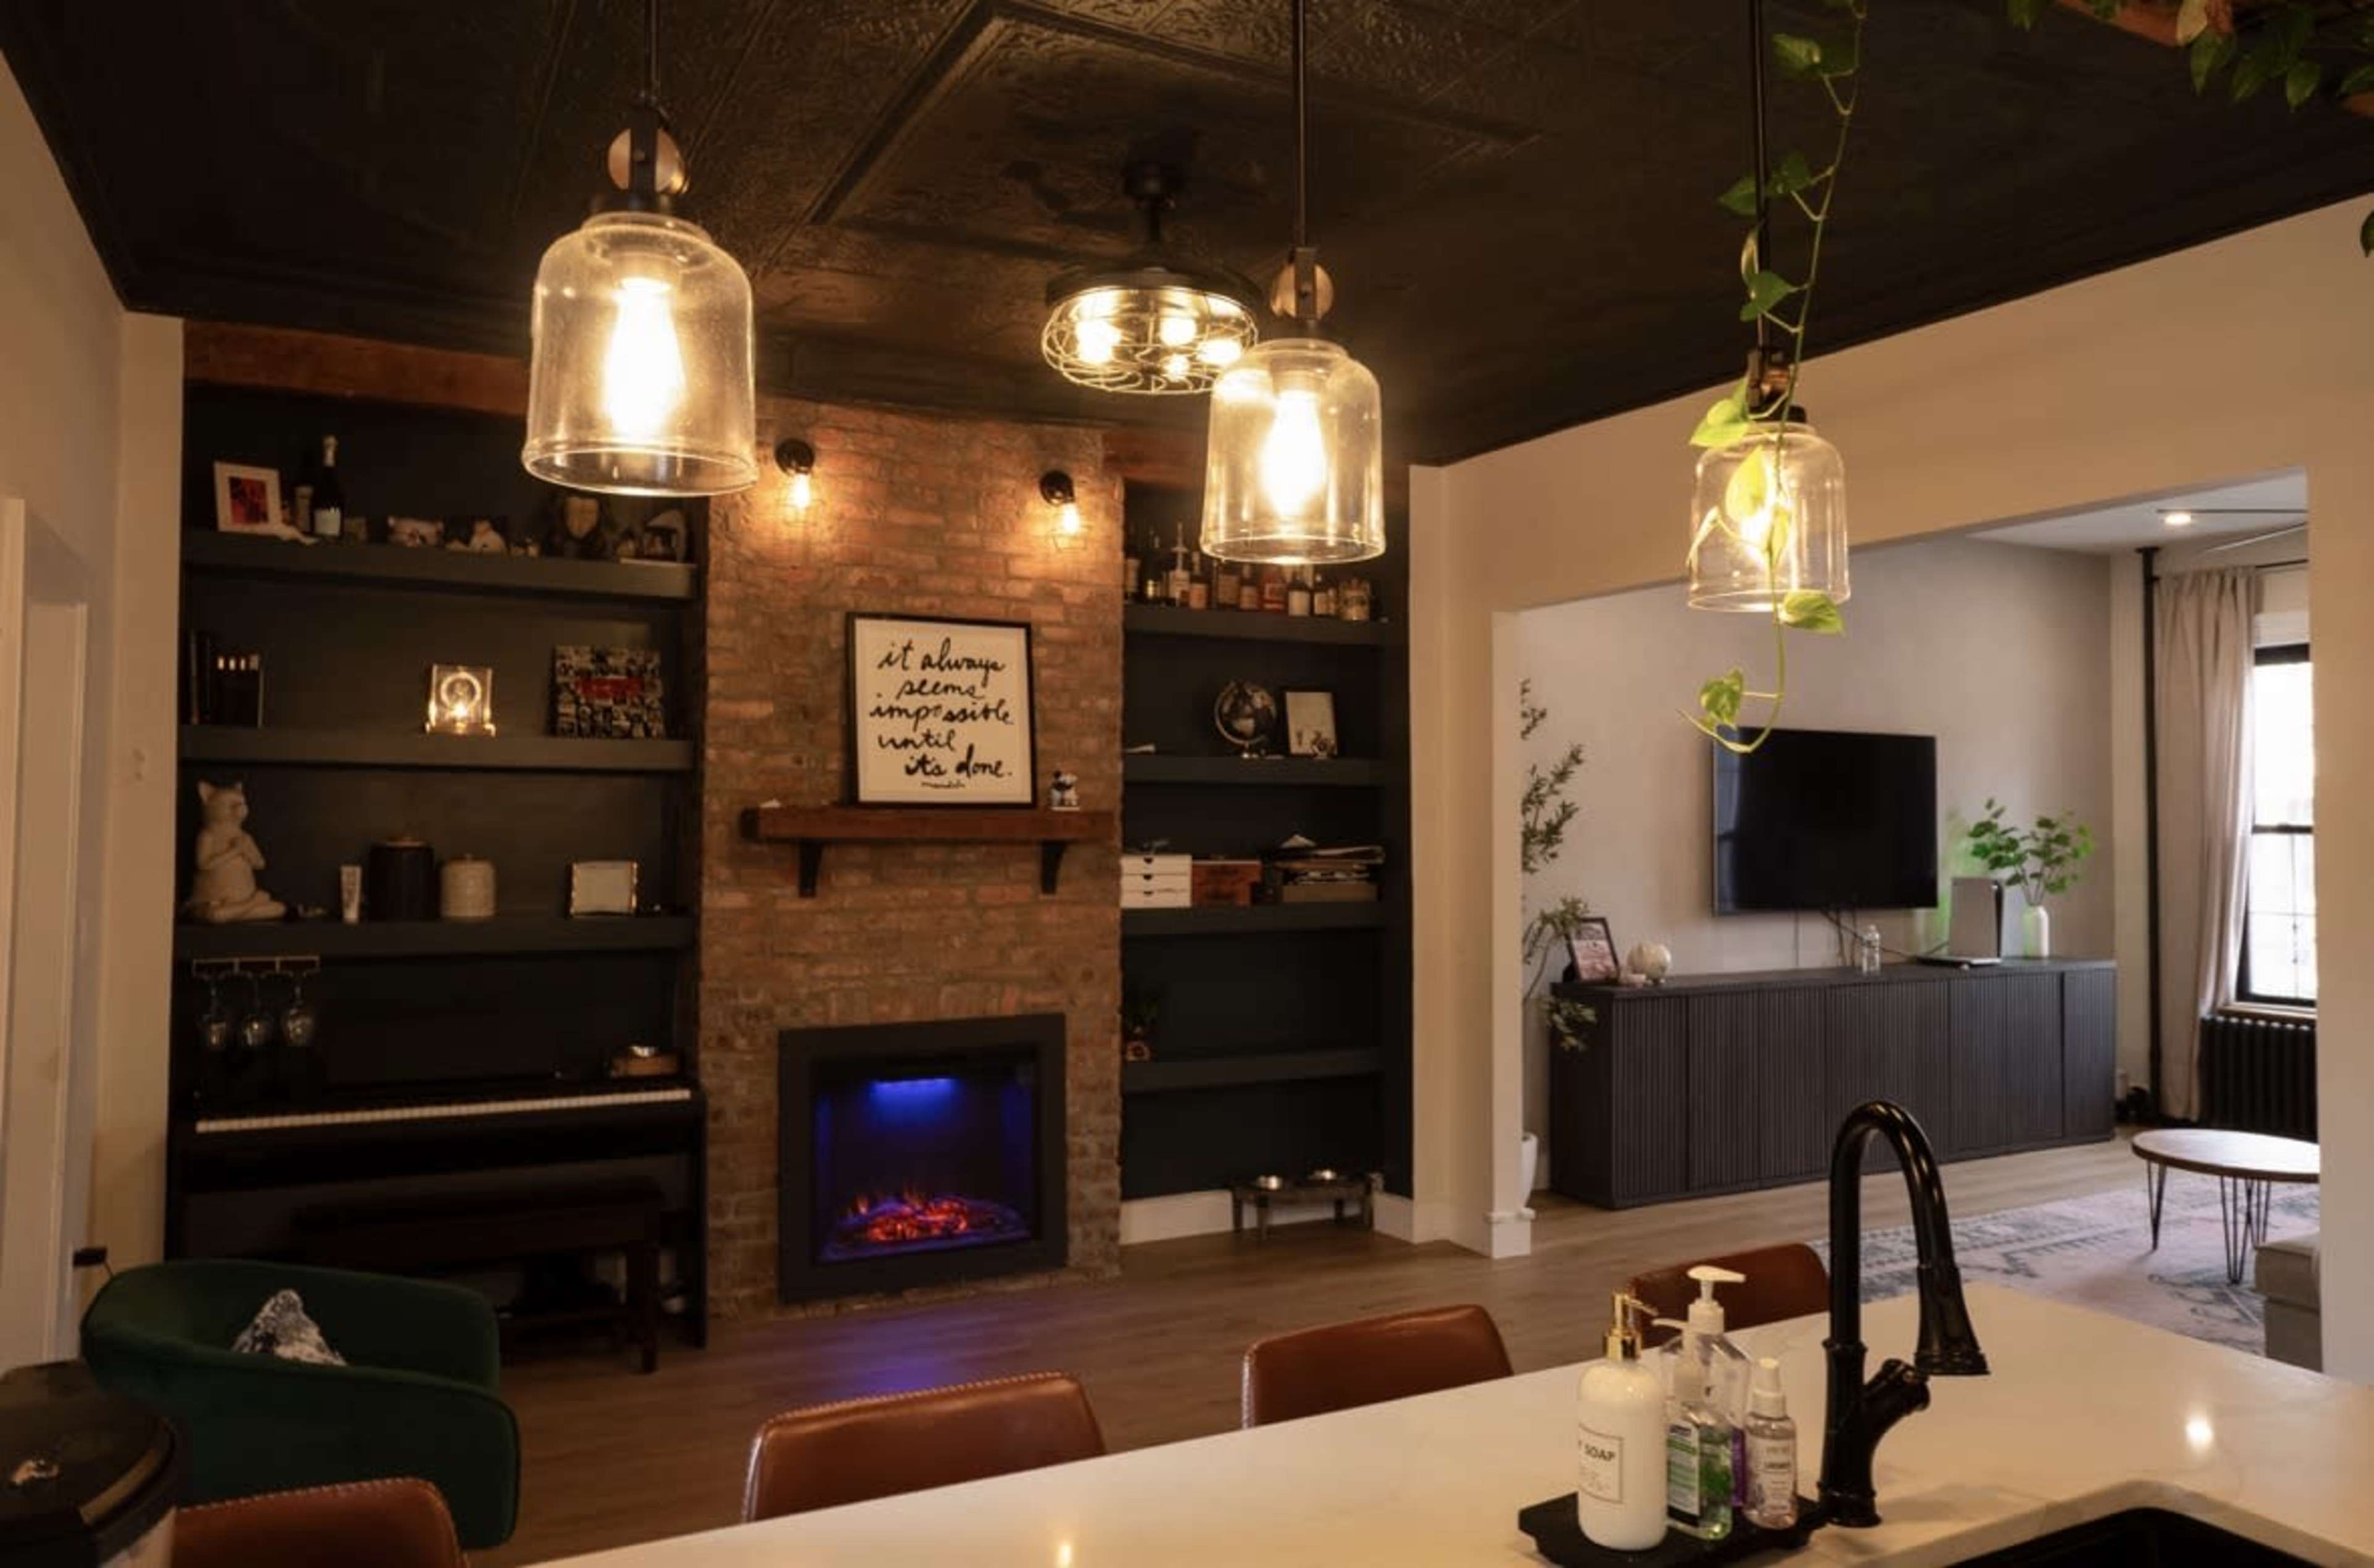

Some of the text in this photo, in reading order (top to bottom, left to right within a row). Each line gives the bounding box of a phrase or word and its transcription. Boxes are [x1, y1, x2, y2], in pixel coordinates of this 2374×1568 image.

[877, 637, 1005, 687] it always
[896, 679, 984, 701] seems
[869, 692, 1013, 731] impossible
[878, 729, 956, 750] until
[905, 744, 1013, 778] it's done.
[1585, 1443, 1615, 1462] SOAP
